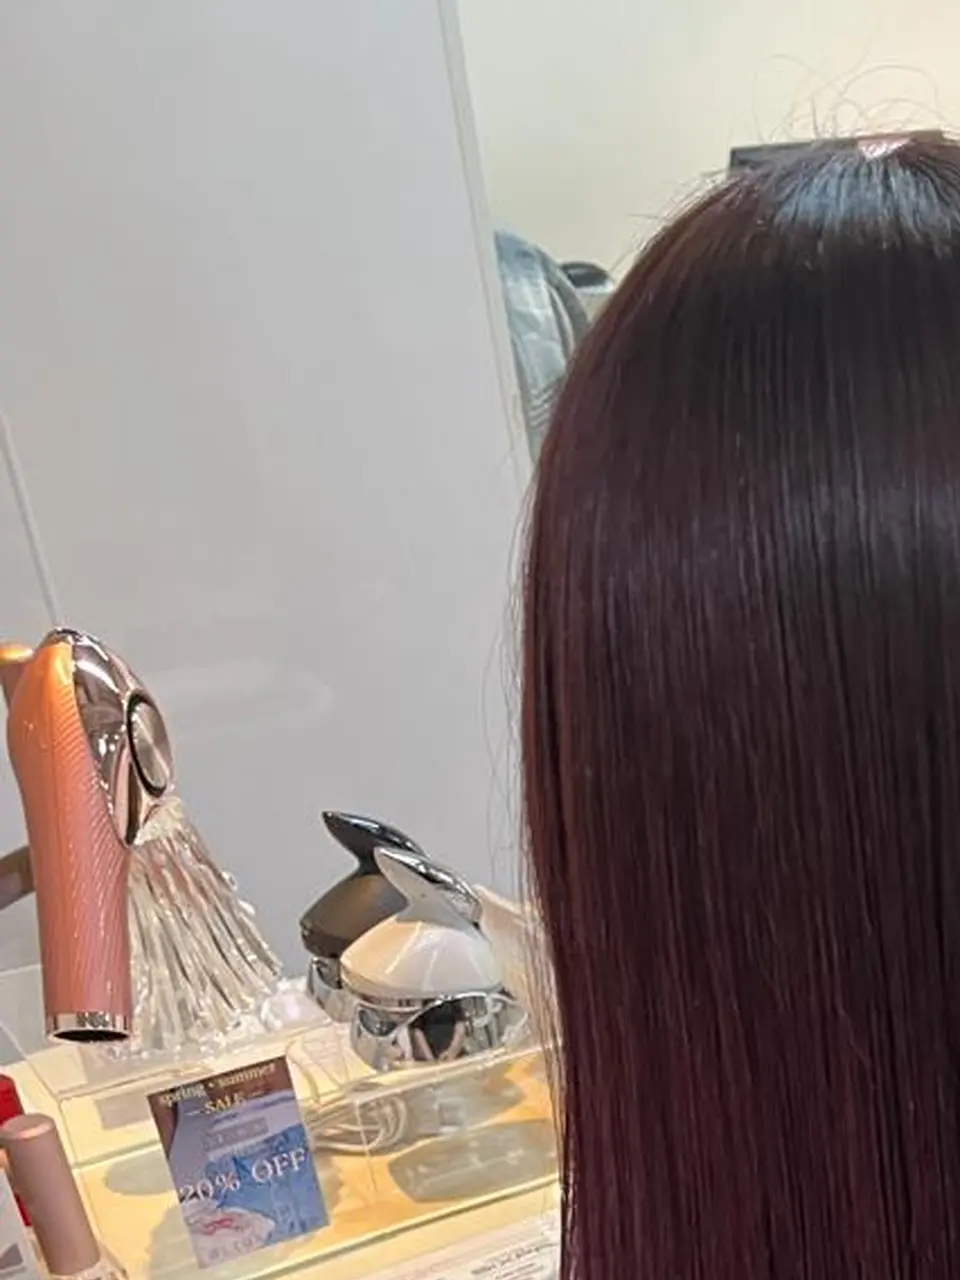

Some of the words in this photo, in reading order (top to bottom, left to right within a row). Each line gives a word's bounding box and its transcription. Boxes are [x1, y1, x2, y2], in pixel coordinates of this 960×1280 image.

[215, 1063, 276, 1088] summer
[205, 1090, 246, 1114] SALE
[179, 1171, 241, 1204] 20%
[251, 1148, 306, 1184] OFF
